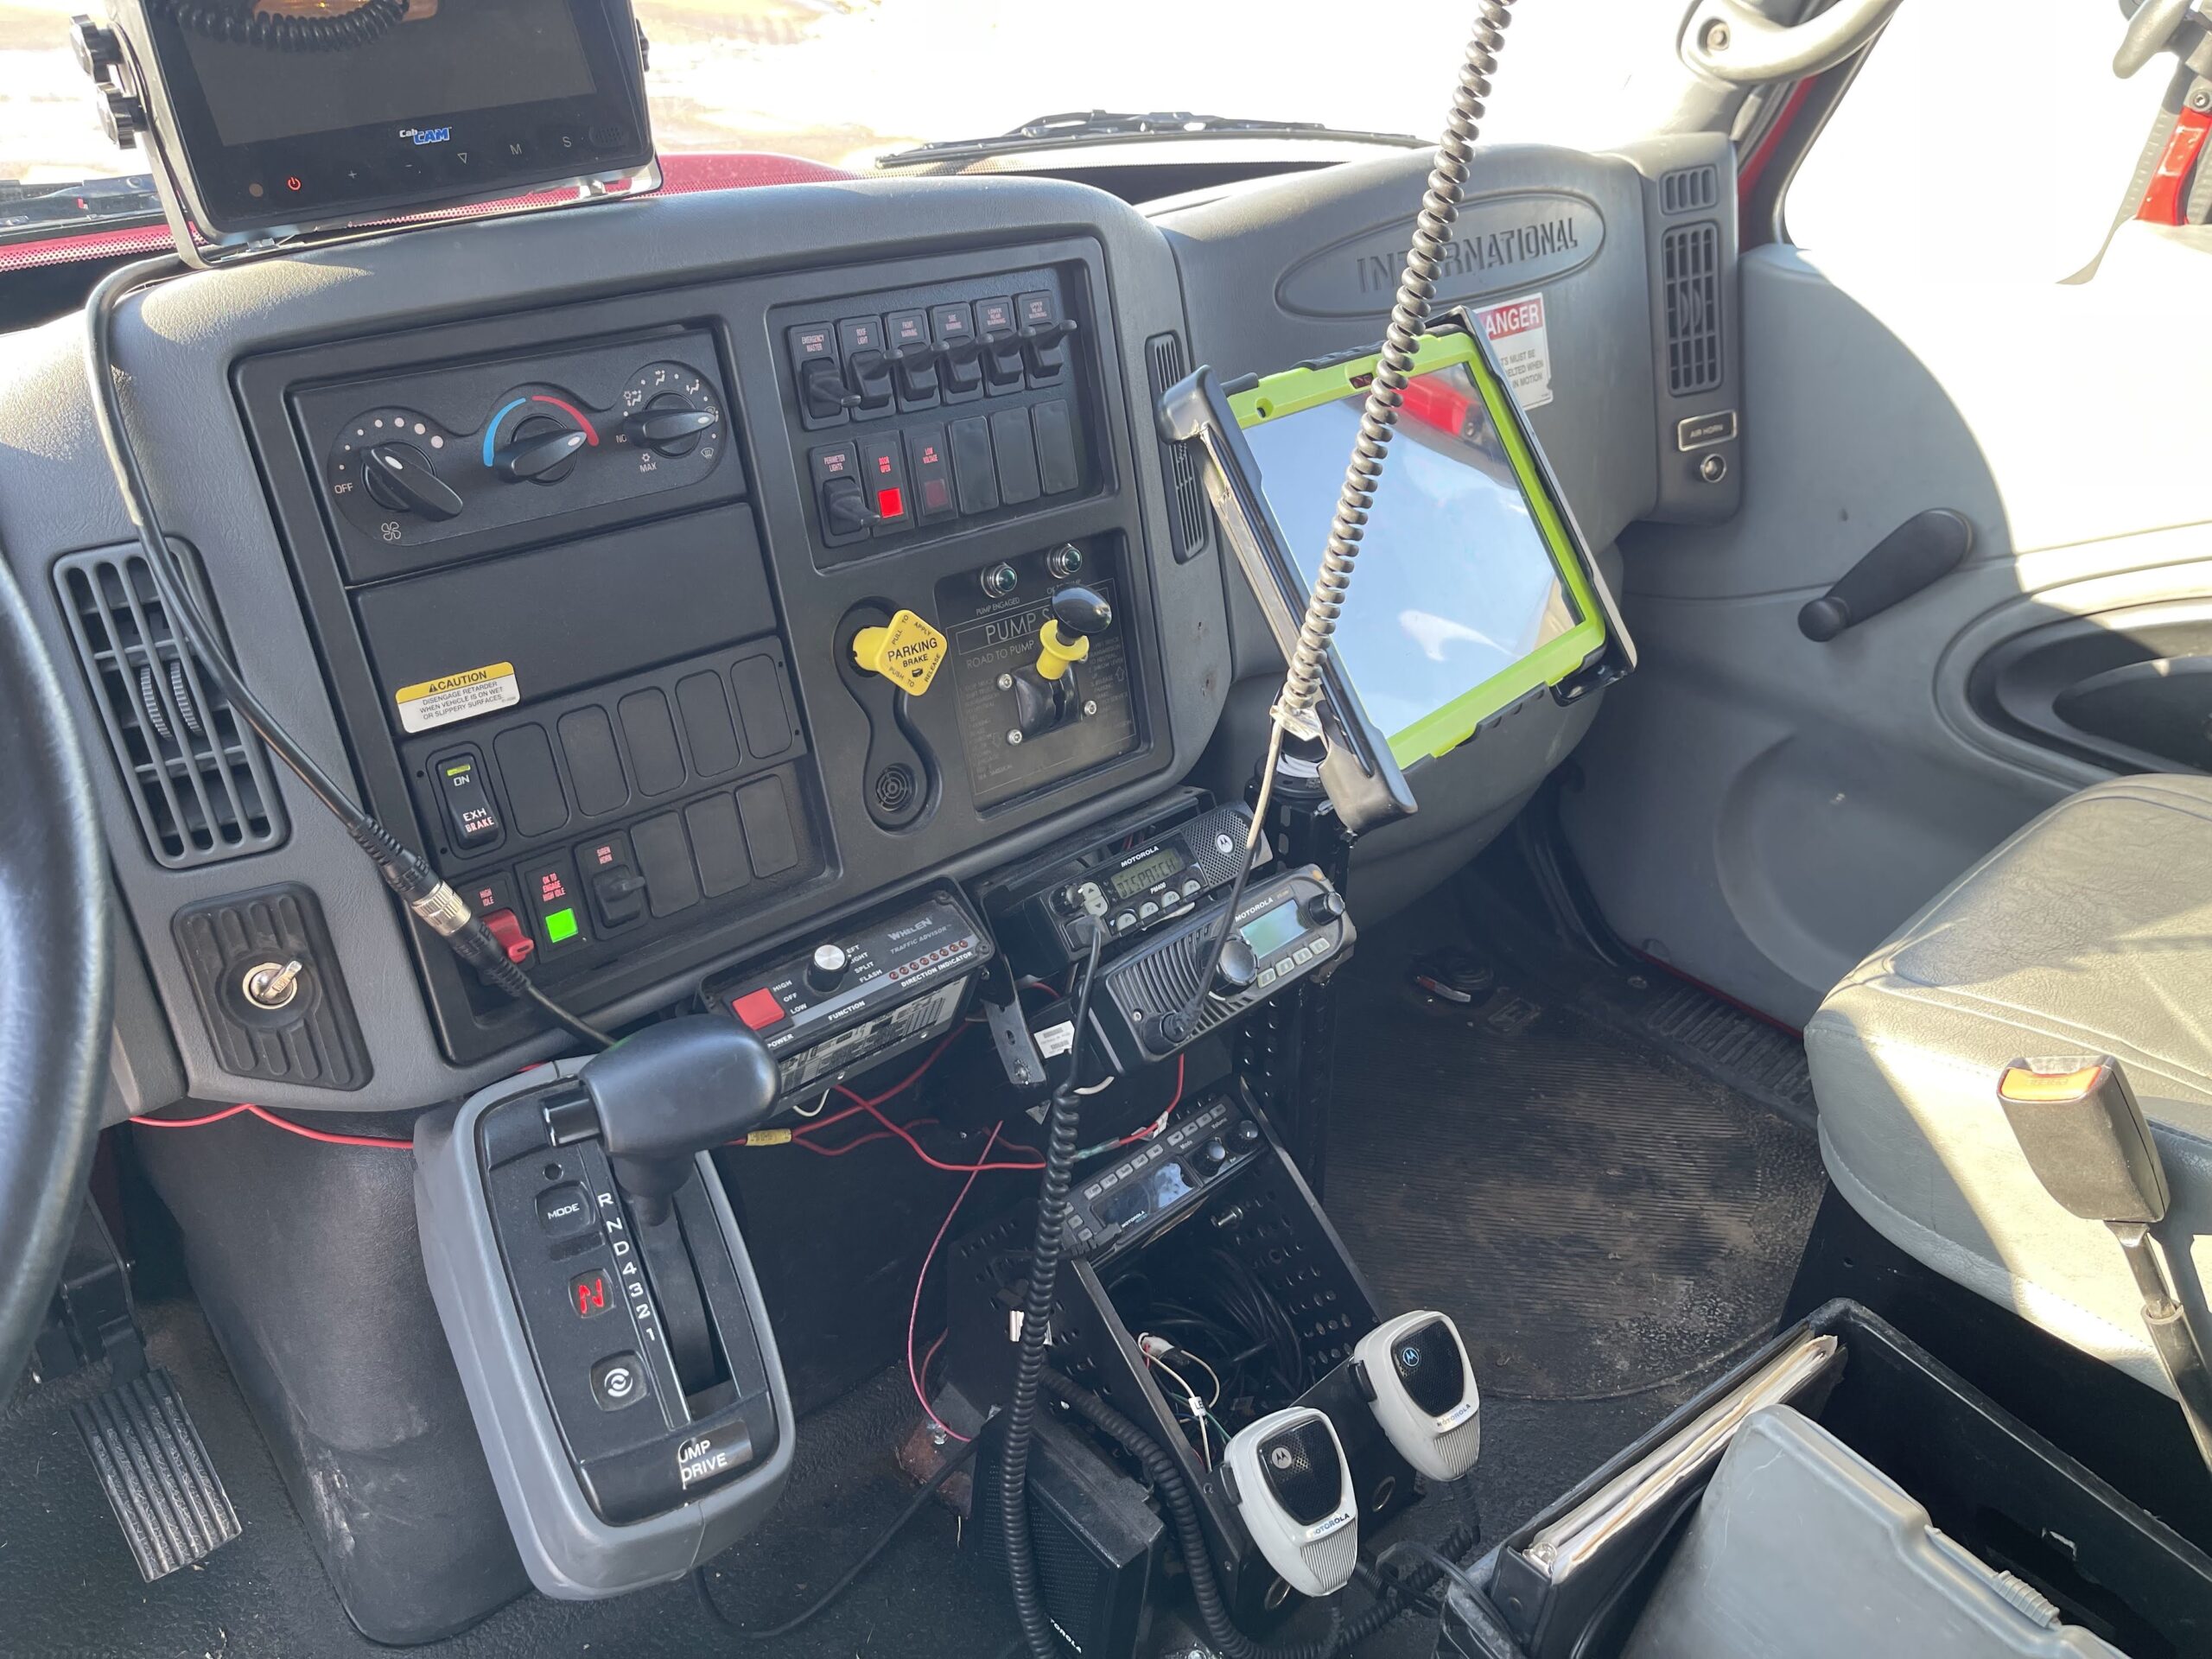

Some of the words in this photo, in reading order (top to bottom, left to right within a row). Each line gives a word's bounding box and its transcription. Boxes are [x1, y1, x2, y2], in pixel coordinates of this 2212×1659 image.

[510, 143, 523, 156] M
[563, 136, 572, 148] S
[1357, 217, 1579, 294] INRNATIONAL
[1485, 303, 1540, 335] ANGER
[1507, 365, 1526, 378] ELTED
[639, 461, 657, 473] MAX
[334, 482, 353, 494] OFF
[976, 607, 991, 616] PUMP
[992, 596, 1020, 611] ENGAGED
[891, 629, 904, 646] PULL
[900, 614, 909, 625] TO
[913, 621, 931, 636] APPLY
[985, 612, 1037, 645] PUMP
[887, 637, 938, 662] PARKING
[966, 653, 994, 670] ROAD
[995, 648, 1008, 661] TO
[1009, 639, 1035, 656] PUMP
[902, 653, 929, 668] BRAKE
[888, 665, 905, 681] PUSH
[907, 678, 915, 688] TO
[924, 652, 941, 683] RELEASE
[437, 670, 488, 691] CAUTION
[419, 704, 441, 714] WHEN
[442, 696, 470, 708] VEHICLE
[488, 686, 503, 696] WET
[422, 691, 461, 706] DISENGAGE
[462, 681, 498, 695] RETARDER
[435, 704, 466, 718] SLIPPERY
[453, 774, 470, 787] ON
[462, 807, 487, 822] EXH
[465, 817, 494, 832] BRAKE
[1121, 845, 1160, 868] MOTOROLA
[1116, 857, 1177, 898] DISPATCH
[1150, 881, 1166, 895] PM400
[482, 896, 495, 907] IDLE
[1235, 897, 1274, 922] MOTOROLA
[887, 917, 933, 941] WHELEN
[846, 944, 861, 954] EFT
[890, 938, 918, 955] TRAFFIC
[850, 951, 869, 963] IGHT
[854, 961, 875, 974] SPLIT
[900, 967, 938, 988] DIRECTION
[938, 951, 973, 970] INDICATOR
[859, 969, 883, 983] FLASH
[772, 980, 793, 992] HIGH
[783, 992, 798, 1002] OFF
[790, 1003, 807, 1014] LOW
[828, 1000, 866, 1020] FUNCTION
[767, 1033, 794, 1048] POWER
[597, 1192, 614, 1207] R
[547, 1203, 580, 1219] MODE
[607, 1217, 623, 1233] N
[613, 1241, 630, 1255] D
[622, 1262, 637, 1274] 4
[578, 1278, 604, 1314] N
[628, 1282, 644, 1297] 3
[636, 1303, 651, 1319] 2
[646, 1328, 655, 1341] 1
[678, 1440, 711, 1463] UMP
[681, 1452, 728, 1483] DRIVE
[1311, 1513, 1350, 1535] OTOROLA
[1050, 1618, 1082, 1654] TOROLA
